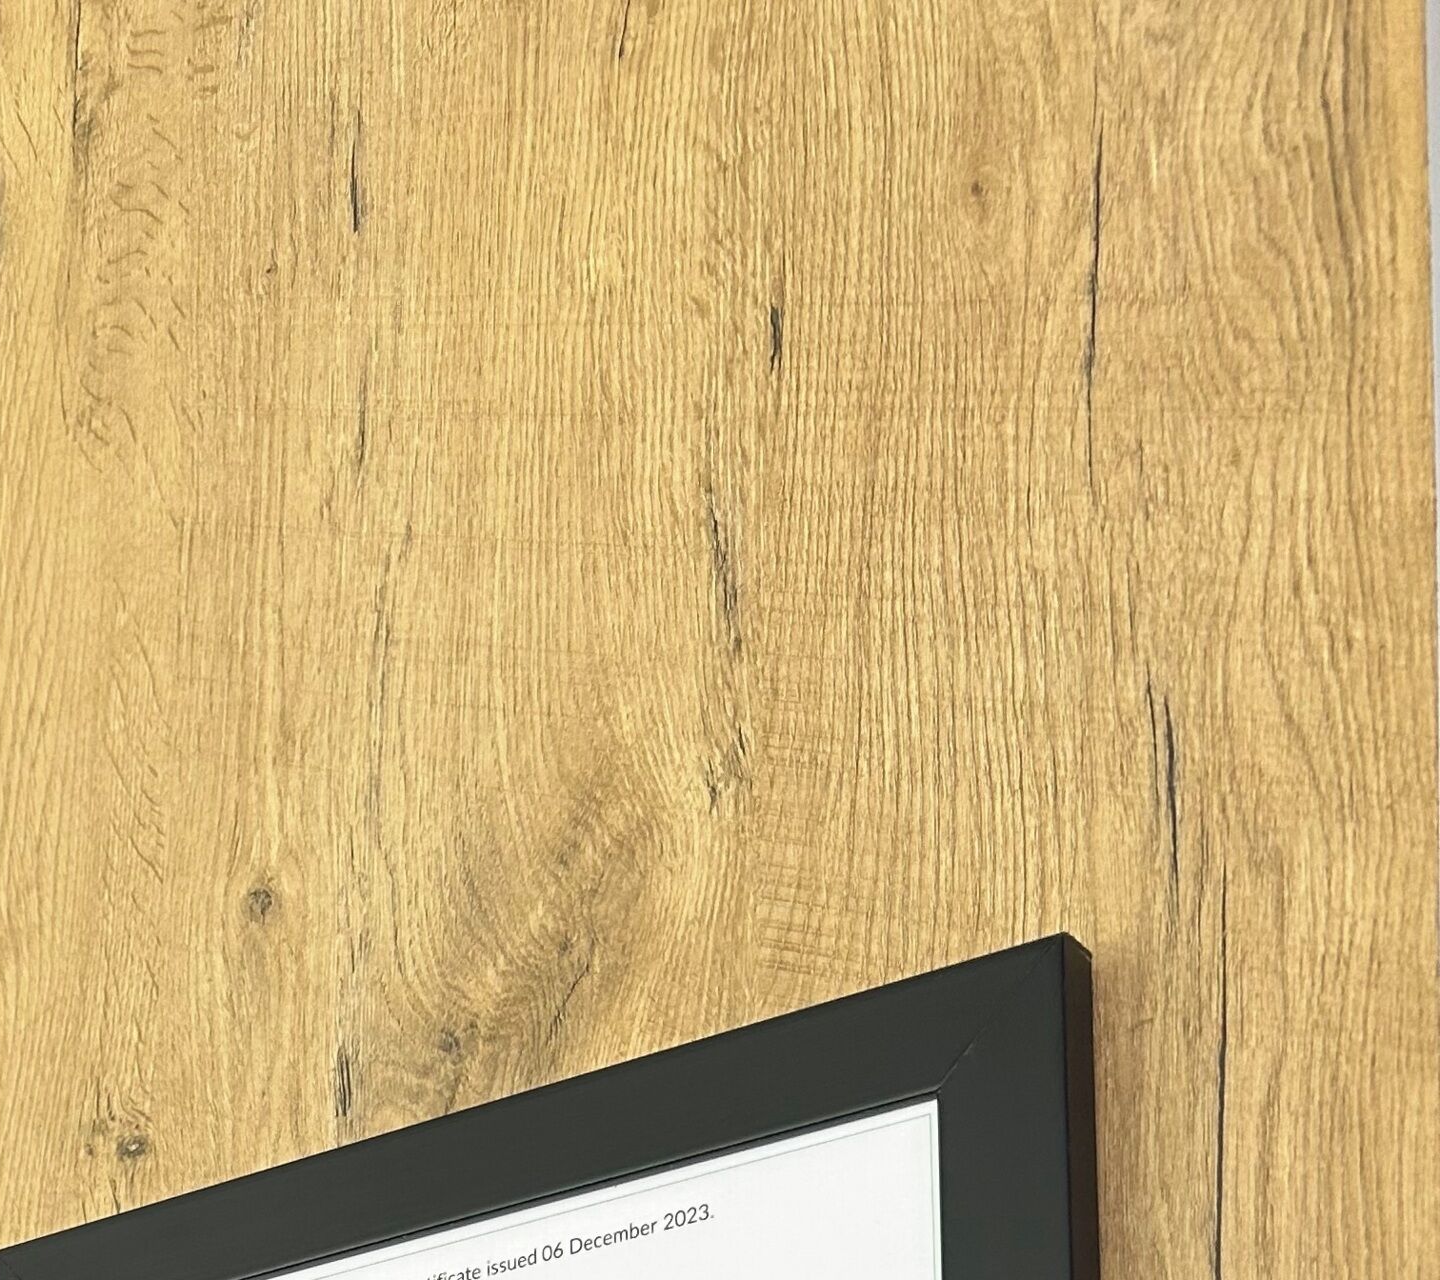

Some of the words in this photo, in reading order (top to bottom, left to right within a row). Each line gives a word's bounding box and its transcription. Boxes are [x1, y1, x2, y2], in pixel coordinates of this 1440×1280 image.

[486, 1247, 538, 1277] issued
[541, 1240, 564, 1262] 06
[569, 1220, 658, 1256] December
[663, 1203, 715, 1232] 2023.
